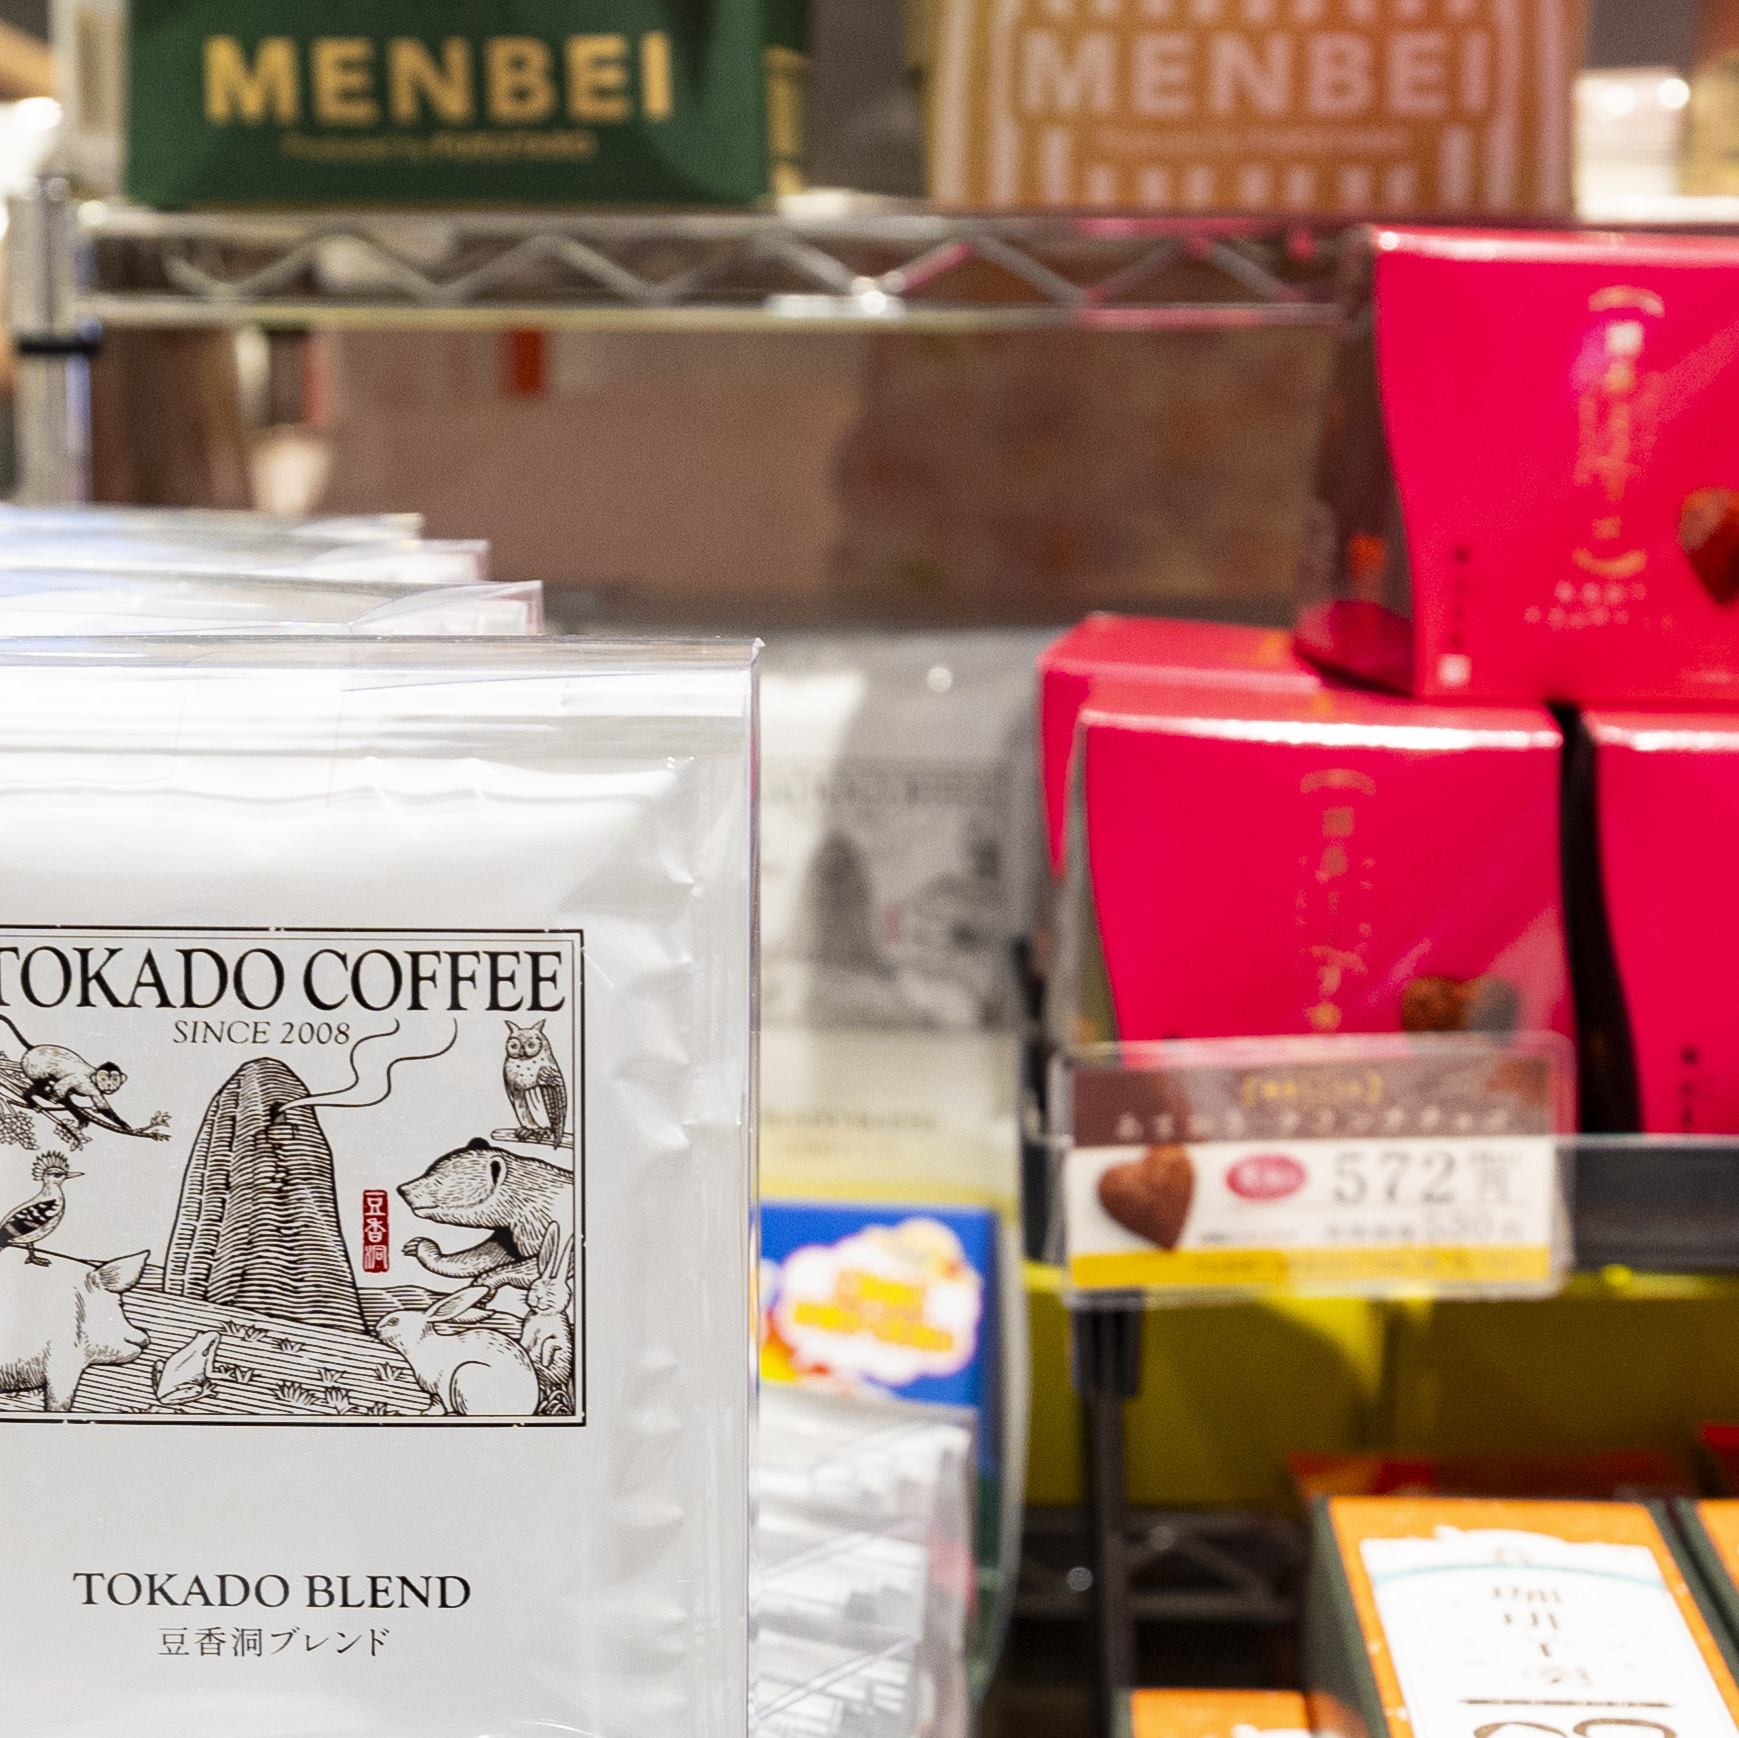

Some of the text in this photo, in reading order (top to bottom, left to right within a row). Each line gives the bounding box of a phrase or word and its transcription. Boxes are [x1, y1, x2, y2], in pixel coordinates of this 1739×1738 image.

[202, 31, 673, 126] MENBEI
[1021, 30, 1491, 118] MENBEI
[303, 949, 565, 1013] COFFEE
[173, 1020, 350, 1045] SINCE 2008
[1333, 1151, 1457, 1204] 572
[73, 1572, 471, 1610] TOKADO BLEND
[159, 1627, 390, 1658] 豆香洞ブレンド
